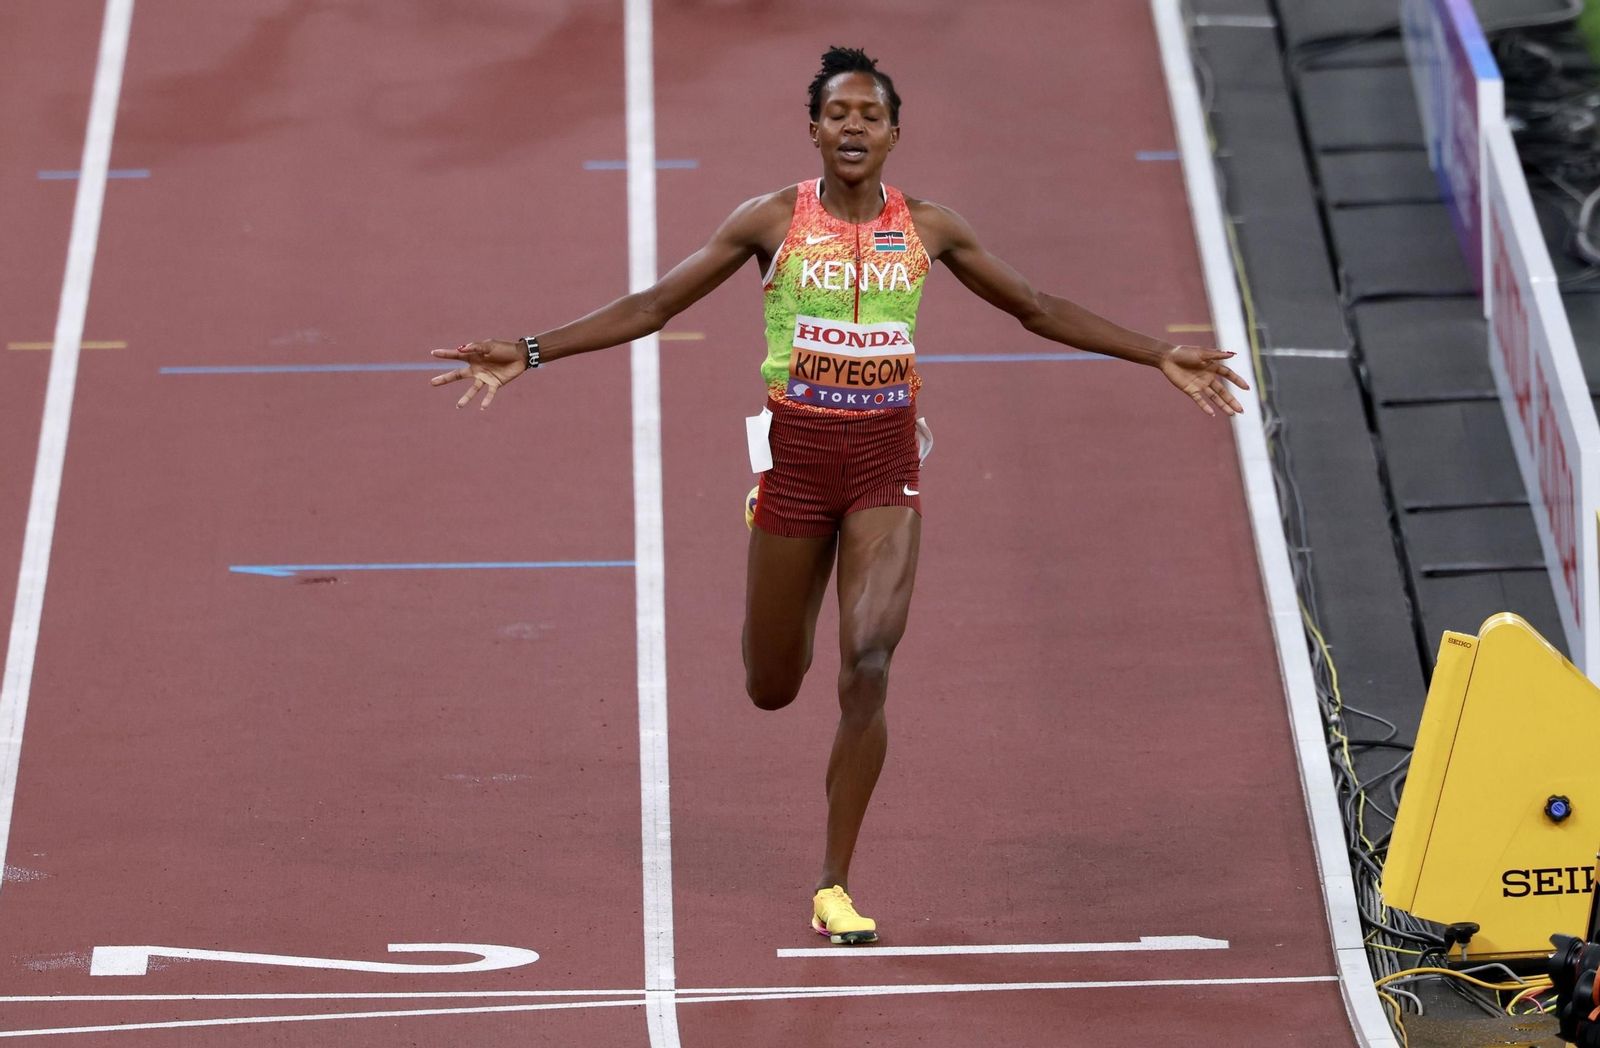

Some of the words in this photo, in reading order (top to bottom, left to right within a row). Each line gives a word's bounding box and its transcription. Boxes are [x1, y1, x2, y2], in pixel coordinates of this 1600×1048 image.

[801, 259, 911, 291] KENYA
[797, 323, 909, 346] HONDA
[795, 352, 909, 386] KIPYEGON
[1448, 637, 1472, 648] SEIKO
